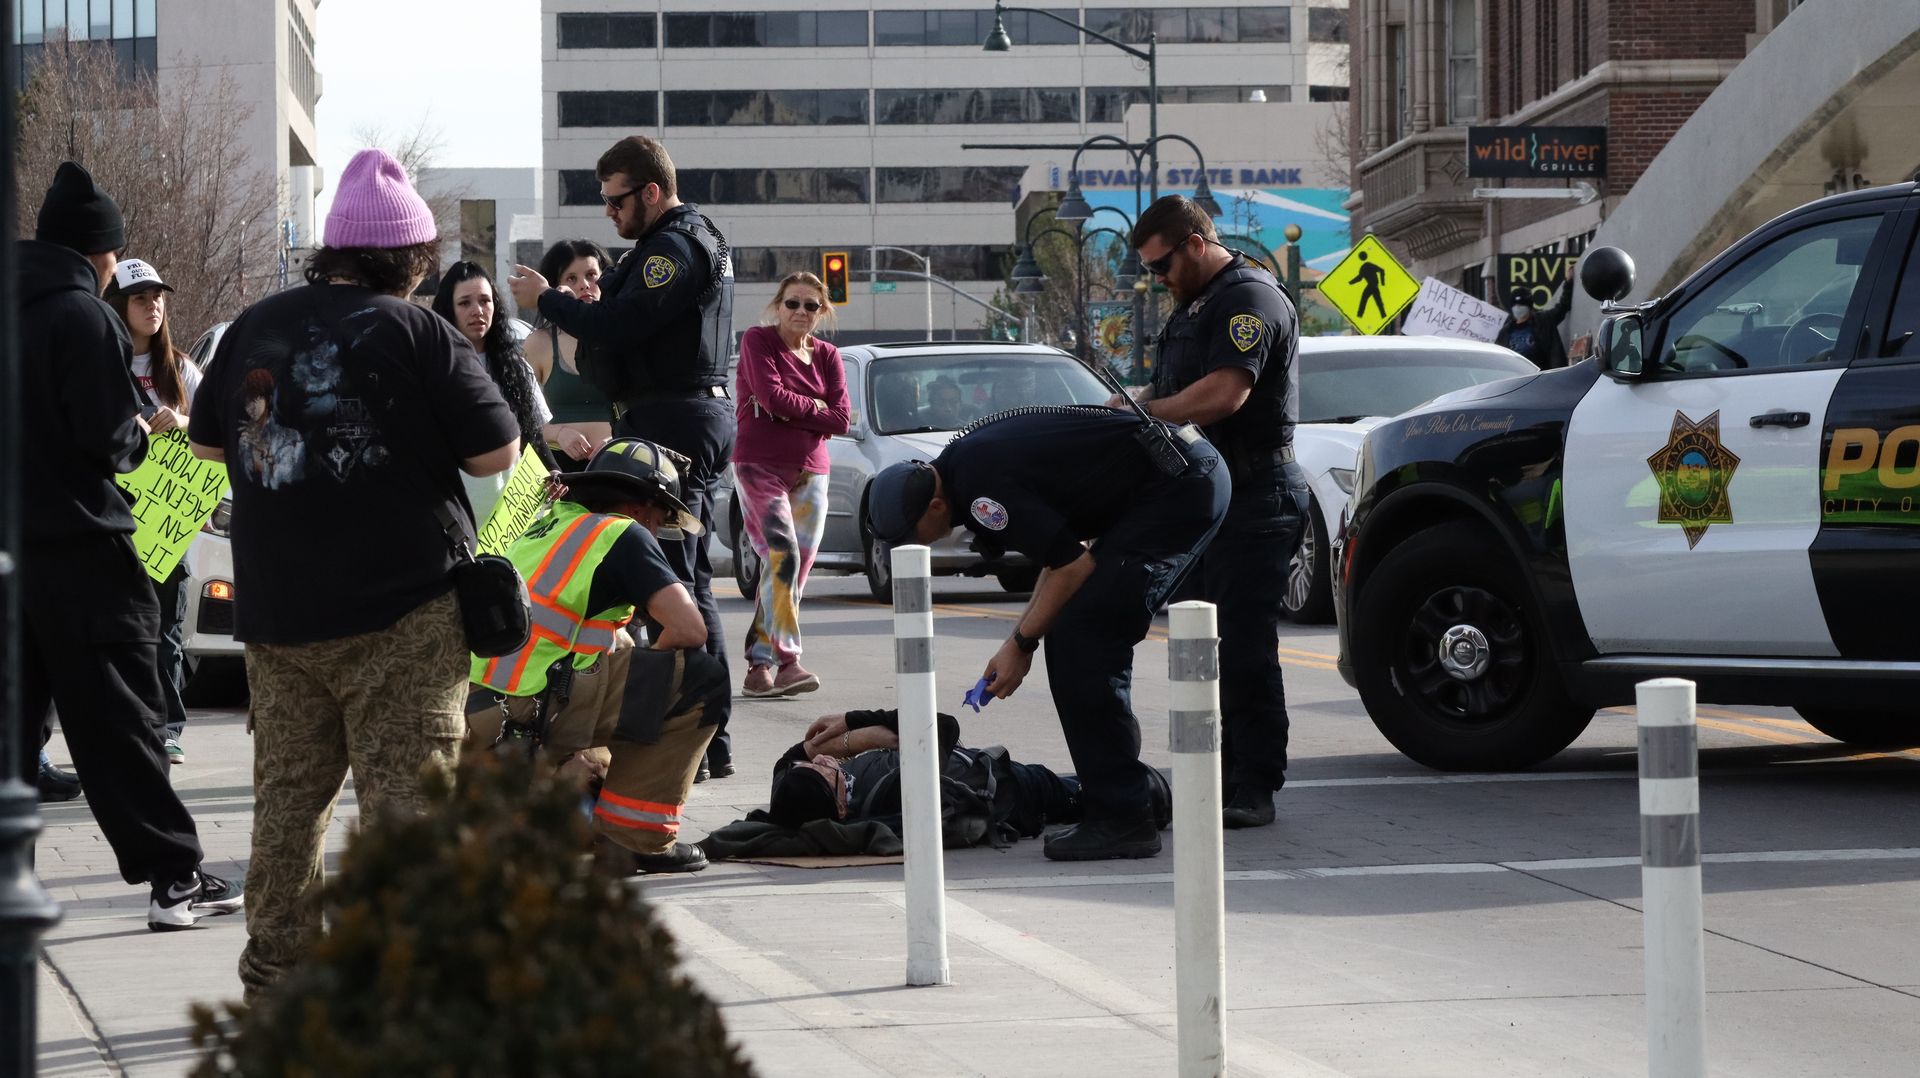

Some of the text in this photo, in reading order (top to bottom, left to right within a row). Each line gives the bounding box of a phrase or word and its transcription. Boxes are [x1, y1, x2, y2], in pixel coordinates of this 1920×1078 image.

[1475, 138, 1600, 161] wild river
[1067, 169, 1160, 187] NEVADA
[1167, 168, 1233, 186] STATE
[1240, 168, 1302, 186] BANK
[1540, 163, 1595, 172] GRILLE
[649, 259, 673, 274] POLICE
[1426, 280, 1468, 315] HATE
[1232, 316, 1261, 331] POLICE
[1414, 305, 1457, 329] MAKE
[1425, 414, 1451, 435] Police
[1471, 414, 1515, 436] Community
[201, 467, 226, 501] YA
[146, 473, 212, 523] AGENT
[478, 453, 537, 554] NOT ABOUT
[1673, 500, 1714, 519] POLICE
[1823, 497, 1882, 515] CITY
[157, 514, 193, 544] AN
[140, 543, 173, 575] IF
